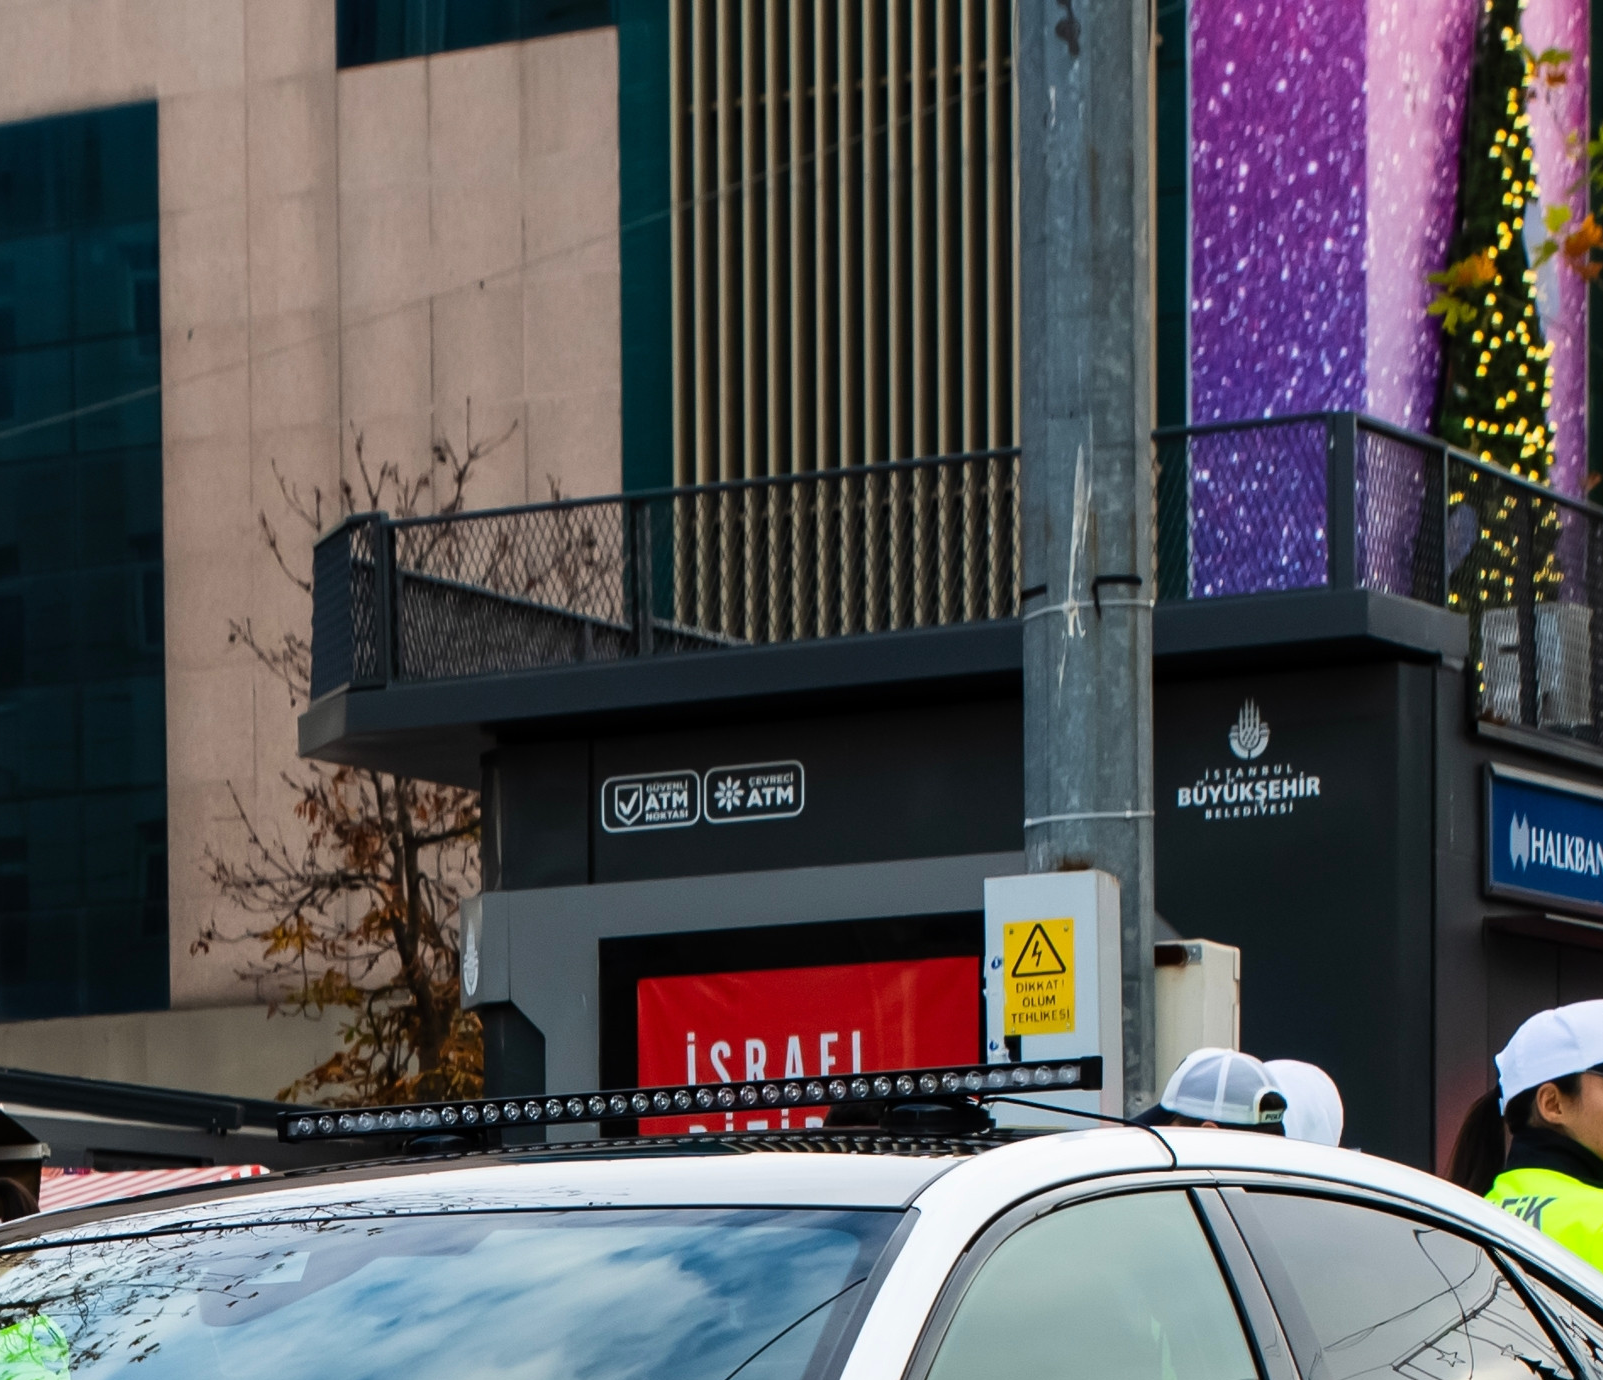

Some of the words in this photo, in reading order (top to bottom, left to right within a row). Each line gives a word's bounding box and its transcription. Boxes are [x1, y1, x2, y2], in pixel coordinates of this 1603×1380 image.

[645, 790, 688, 811] ATM
[746, 785, 794, 808] ATM
[1178, 771, 1321, 809] BÜYÜKŞEHİR
